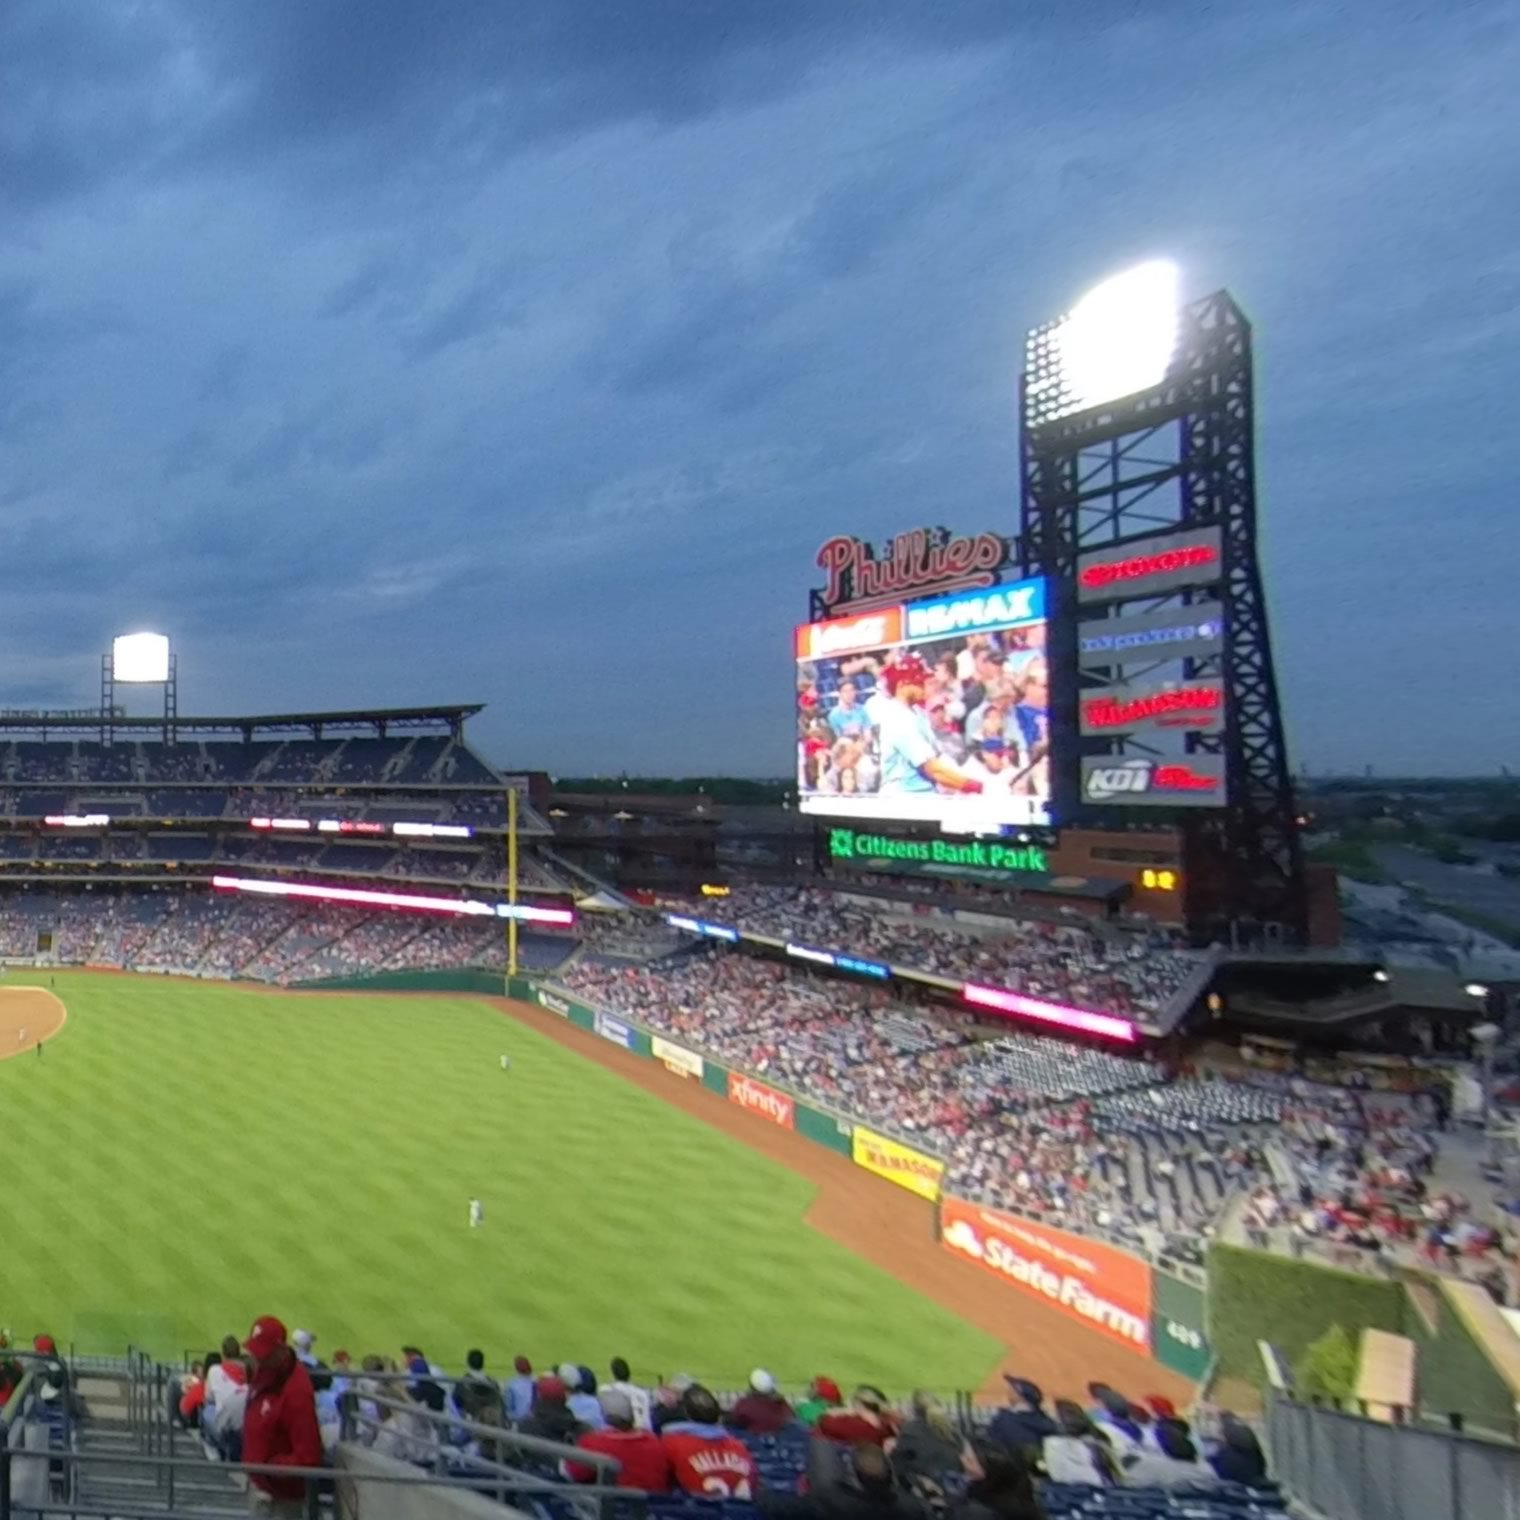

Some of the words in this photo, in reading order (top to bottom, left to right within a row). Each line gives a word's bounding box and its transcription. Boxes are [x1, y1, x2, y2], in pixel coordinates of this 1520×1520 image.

[816, 529, 1003, 606] Phillies
[854, 832, 930, 862] Citizens
[932, 841, 987, 868] Bank
[989, 845, 1046, 873] Park
